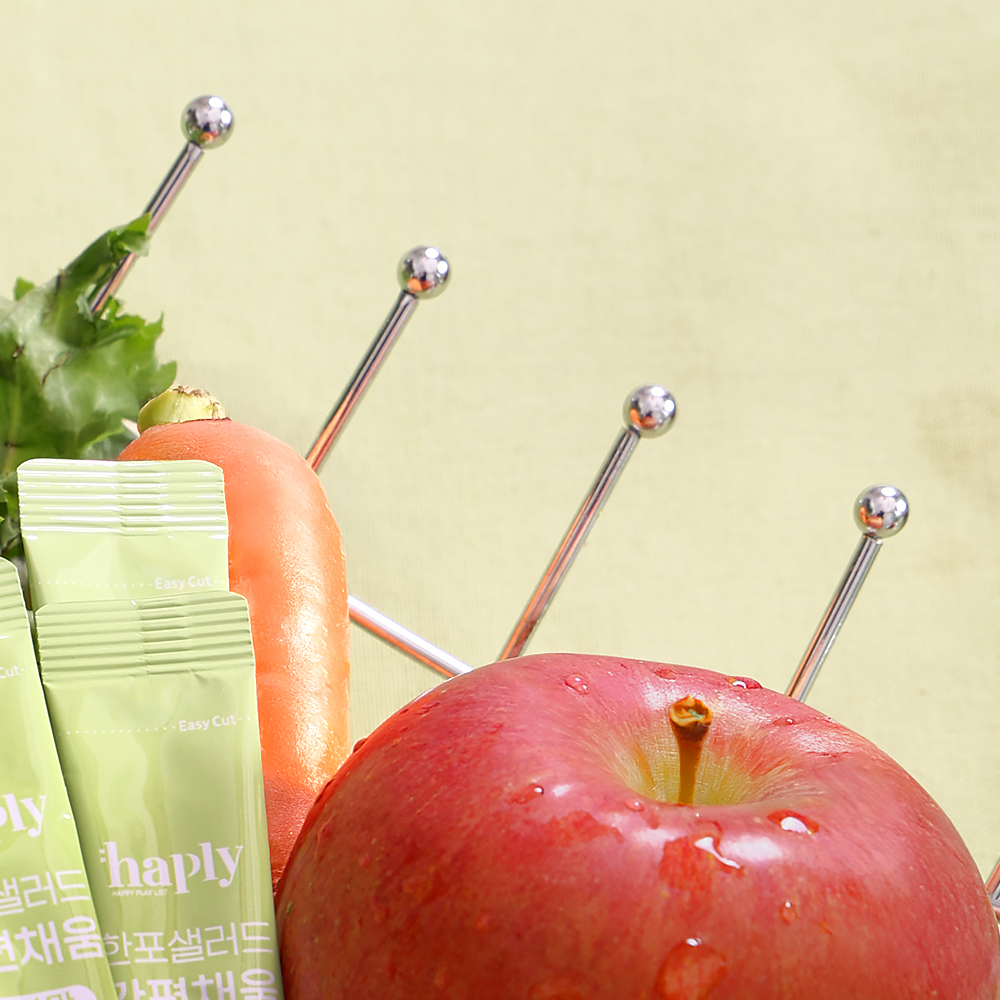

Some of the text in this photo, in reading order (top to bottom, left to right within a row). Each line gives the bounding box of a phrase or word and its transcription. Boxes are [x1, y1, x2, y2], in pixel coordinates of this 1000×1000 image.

[155, 576, 211, 590] Easy Cut
[179, 714, 236, 732] Easy Cut
[102, 922, 274, 966] 한포샐러드
